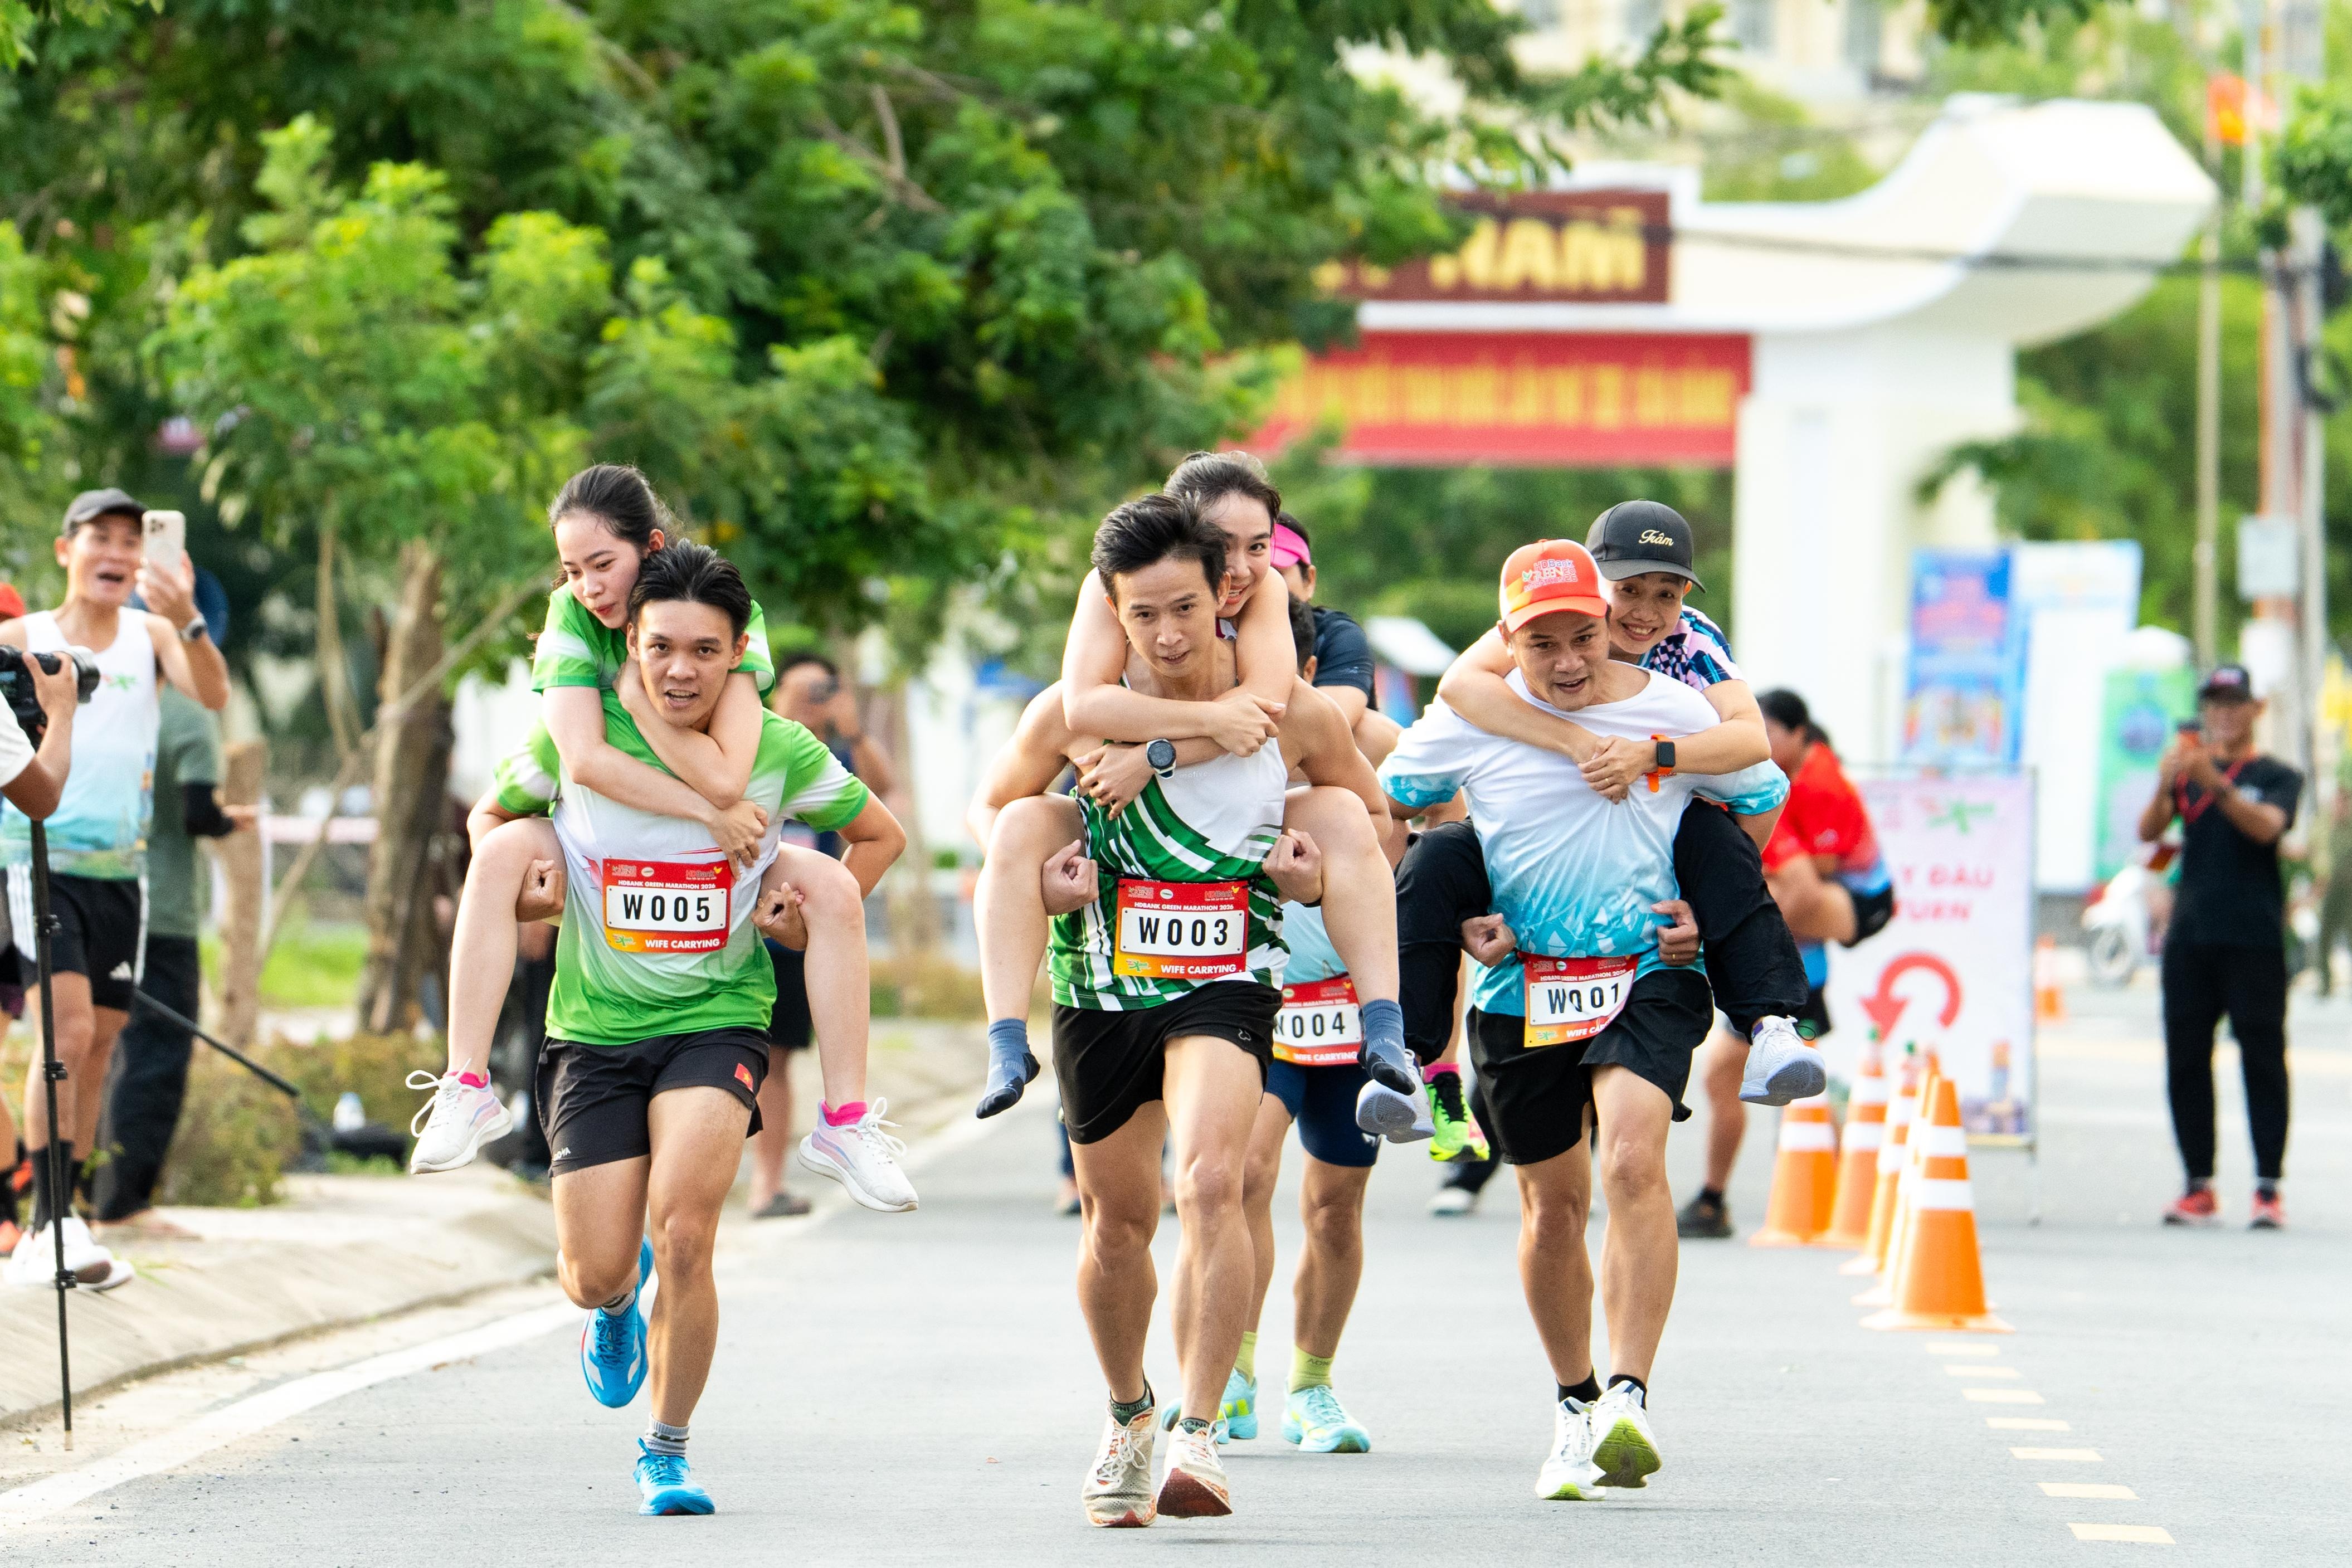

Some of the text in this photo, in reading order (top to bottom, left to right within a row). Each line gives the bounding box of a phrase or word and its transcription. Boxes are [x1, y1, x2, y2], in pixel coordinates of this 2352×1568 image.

[1639, 529, 1674, 546] Trâm
[1533, 559, 1574, 571] HDBank
[623, 893, 710, 922] W005
[1138, 917, 1228, 946] W003
[645, 939, 669, 948] WIFE
[670, 938, 720, 948] CARRYING
[1161, 965, 1185, 974] WIFE
[1187, 964, 1236, 975] CARRYING
[1579, 972, 1611, 981] MARATHON
[1547, 982, 1619, 1013] W001
[1566, 1028, 1588, 1038] WIFE
[1313, 1051, 1357, 1061] CARRYING
